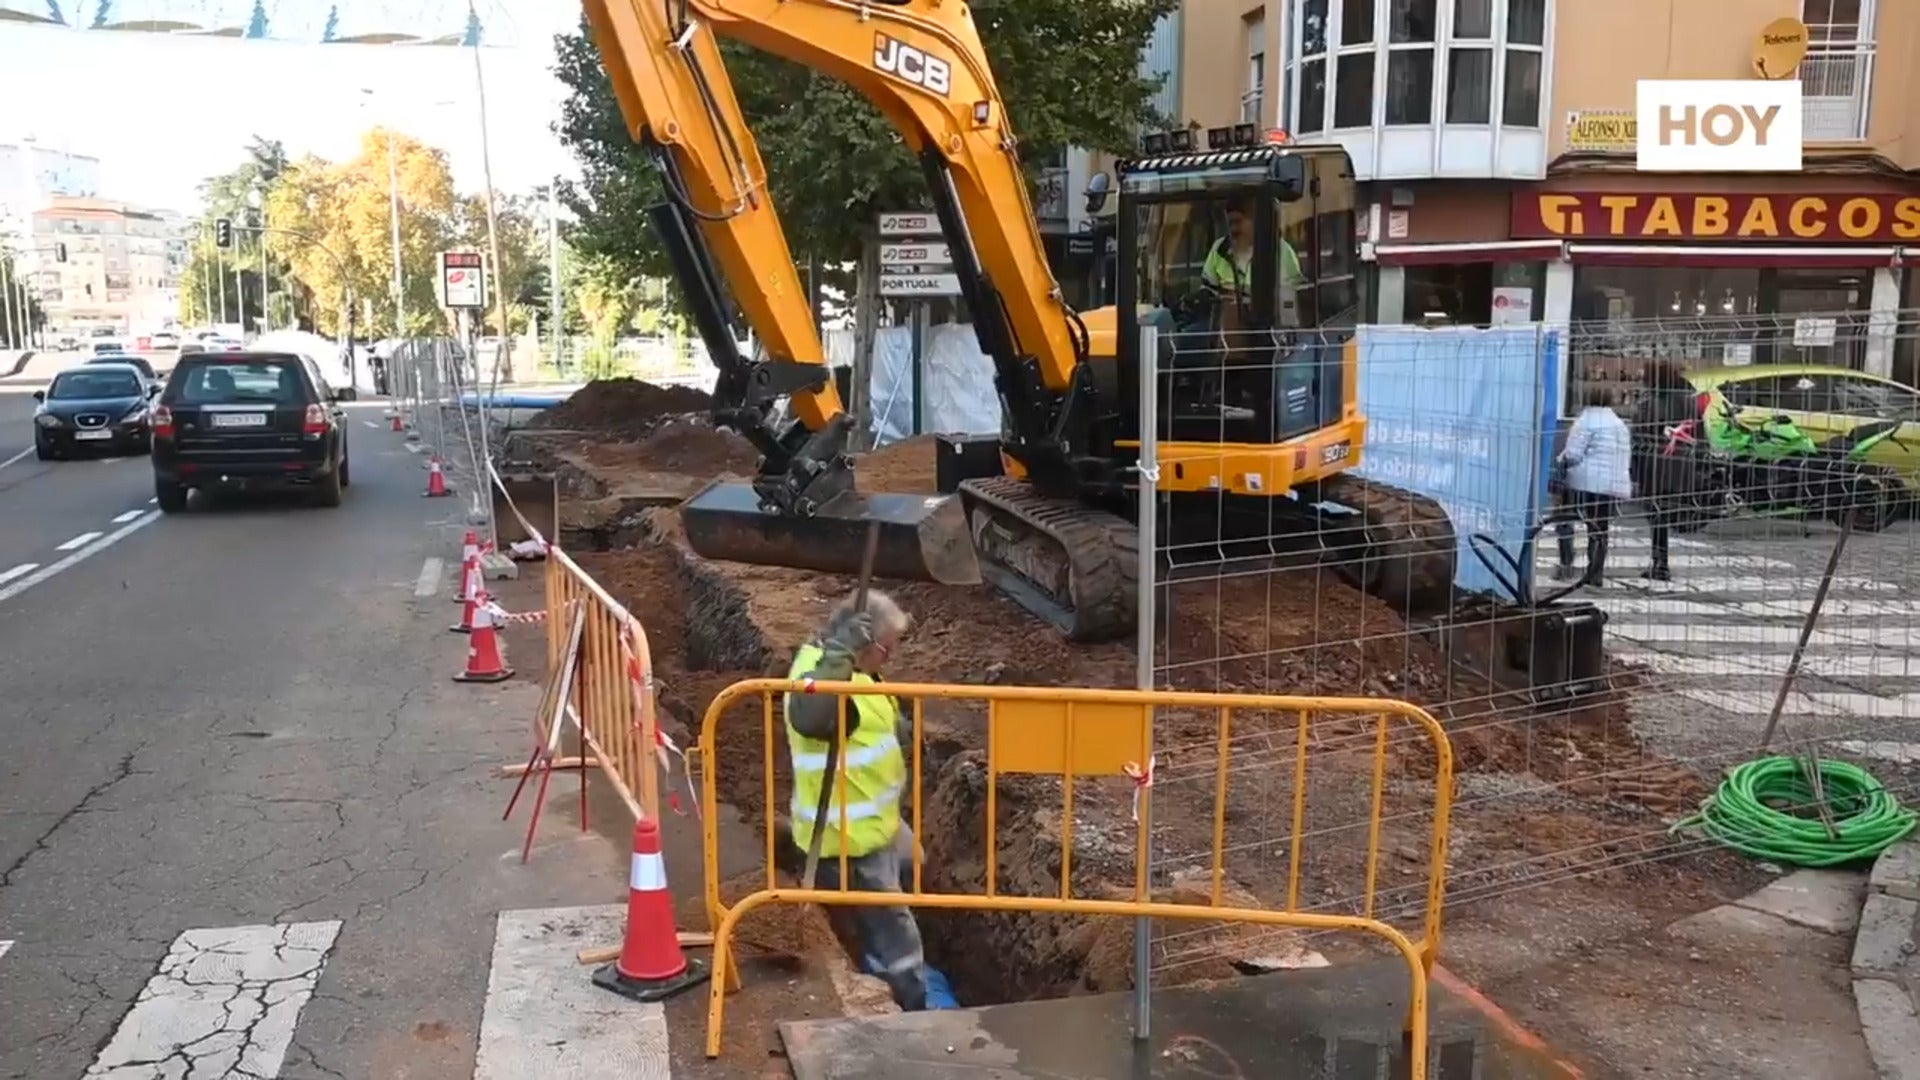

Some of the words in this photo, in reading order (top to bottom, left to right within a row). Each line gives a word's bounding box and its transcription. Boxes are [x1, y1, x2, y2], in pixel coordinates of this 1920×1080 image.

[875, 39, 949, 95] JCB
[1577, 120, 1619, 137] ALFONSO
[1600, 197, 1920, 238] TABACOS
[882, 279, 940, 289] PORTUGAL
